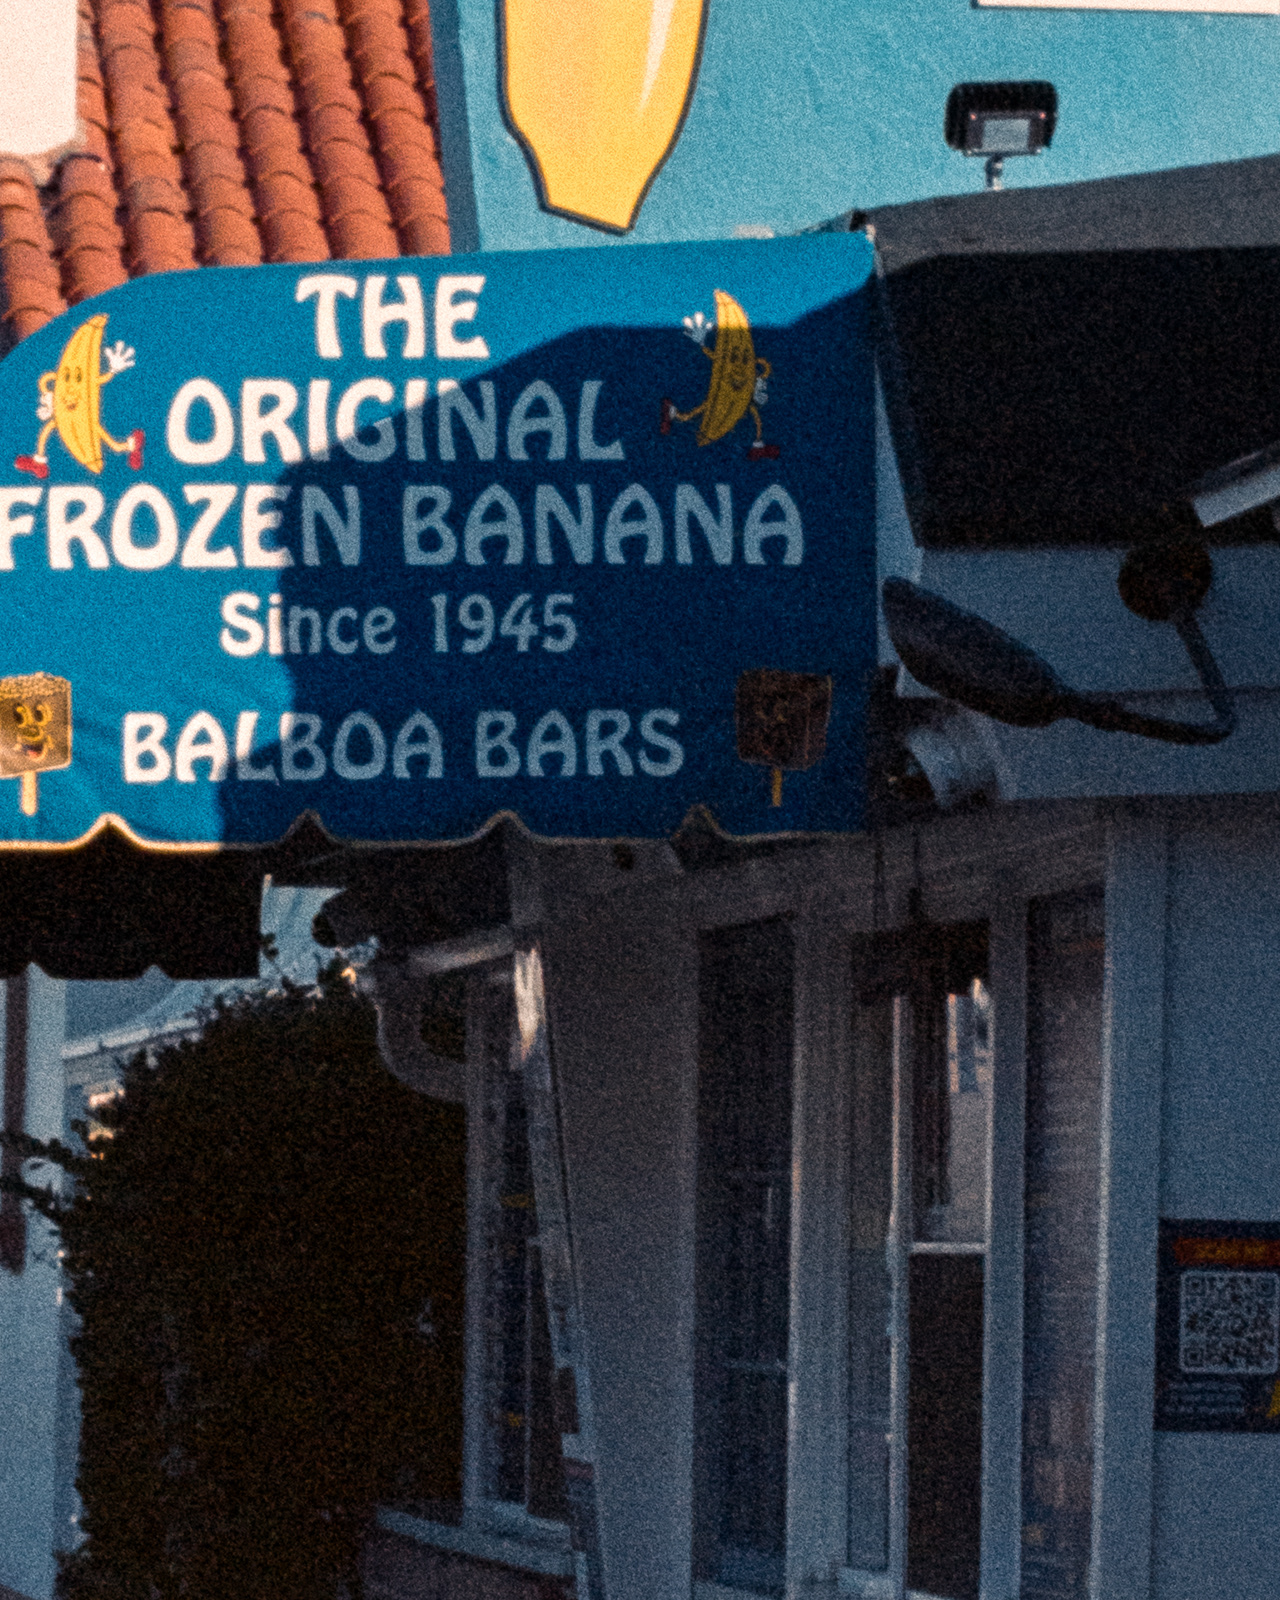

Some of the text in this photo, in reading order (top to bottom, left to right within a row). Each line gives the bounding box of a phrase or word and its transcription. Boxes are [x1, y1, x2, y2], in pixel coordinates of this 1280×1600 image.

[295, 273, 489, 359] THE
[165, 376, 625, 464] ORIGINAL
[403, 483, 804, 567] BANANA
[220, 592, 578, 658] Since 1945
[122, 708, 684, 786] BALBOA BARS
